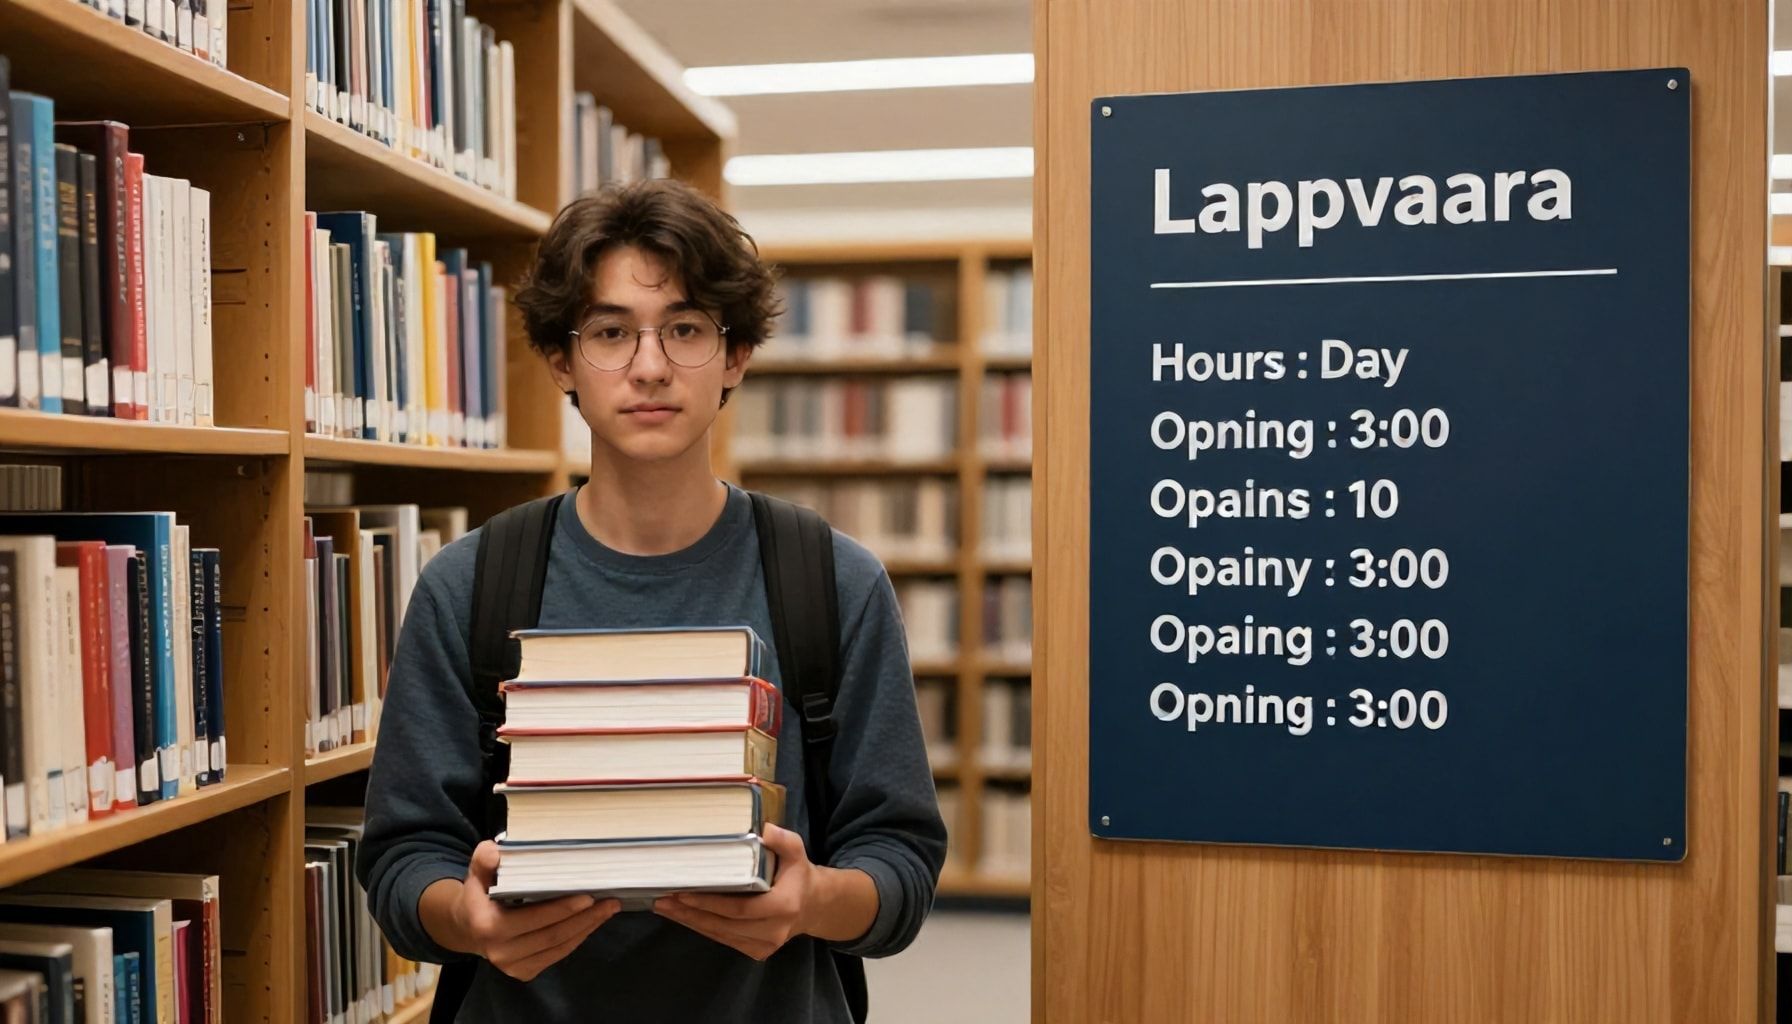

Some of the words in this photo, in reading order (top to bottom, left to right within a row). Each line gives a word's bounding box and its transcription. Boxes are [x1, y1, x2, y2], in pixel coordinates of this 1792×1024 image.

[1153, 168, 1572, 250] Lappvaara
[1152, 342, 1287, 382] Hours
[1298, 351, 1308, 380] :
[1320, 339, 1410, 388] Day
[1150, 408, 1314, 461] Opning
[1327, 420, 1337, 449] :
[1349, 407, 1451, 449] 3:00
[1150, 478, 1311, 529] Opains
[1325, 489, 1336, 518] :
[1348, 478, 1399, 519] 10
[1150, 545, 1313, 598] Opainy
[1325, 559, 1336, 587] :
[1348, 547, 1450, 590] 3:00
[1150, 613, 1313, 666] Opaing
[1326, 628, 1336, 657] :
[1348, 617, 1450, 660] 3:00
[1149, 682, 1313, 736] Opning
[1326, 698, 1336, 727] :
[1347, 687, 1449, 730] 3:00
